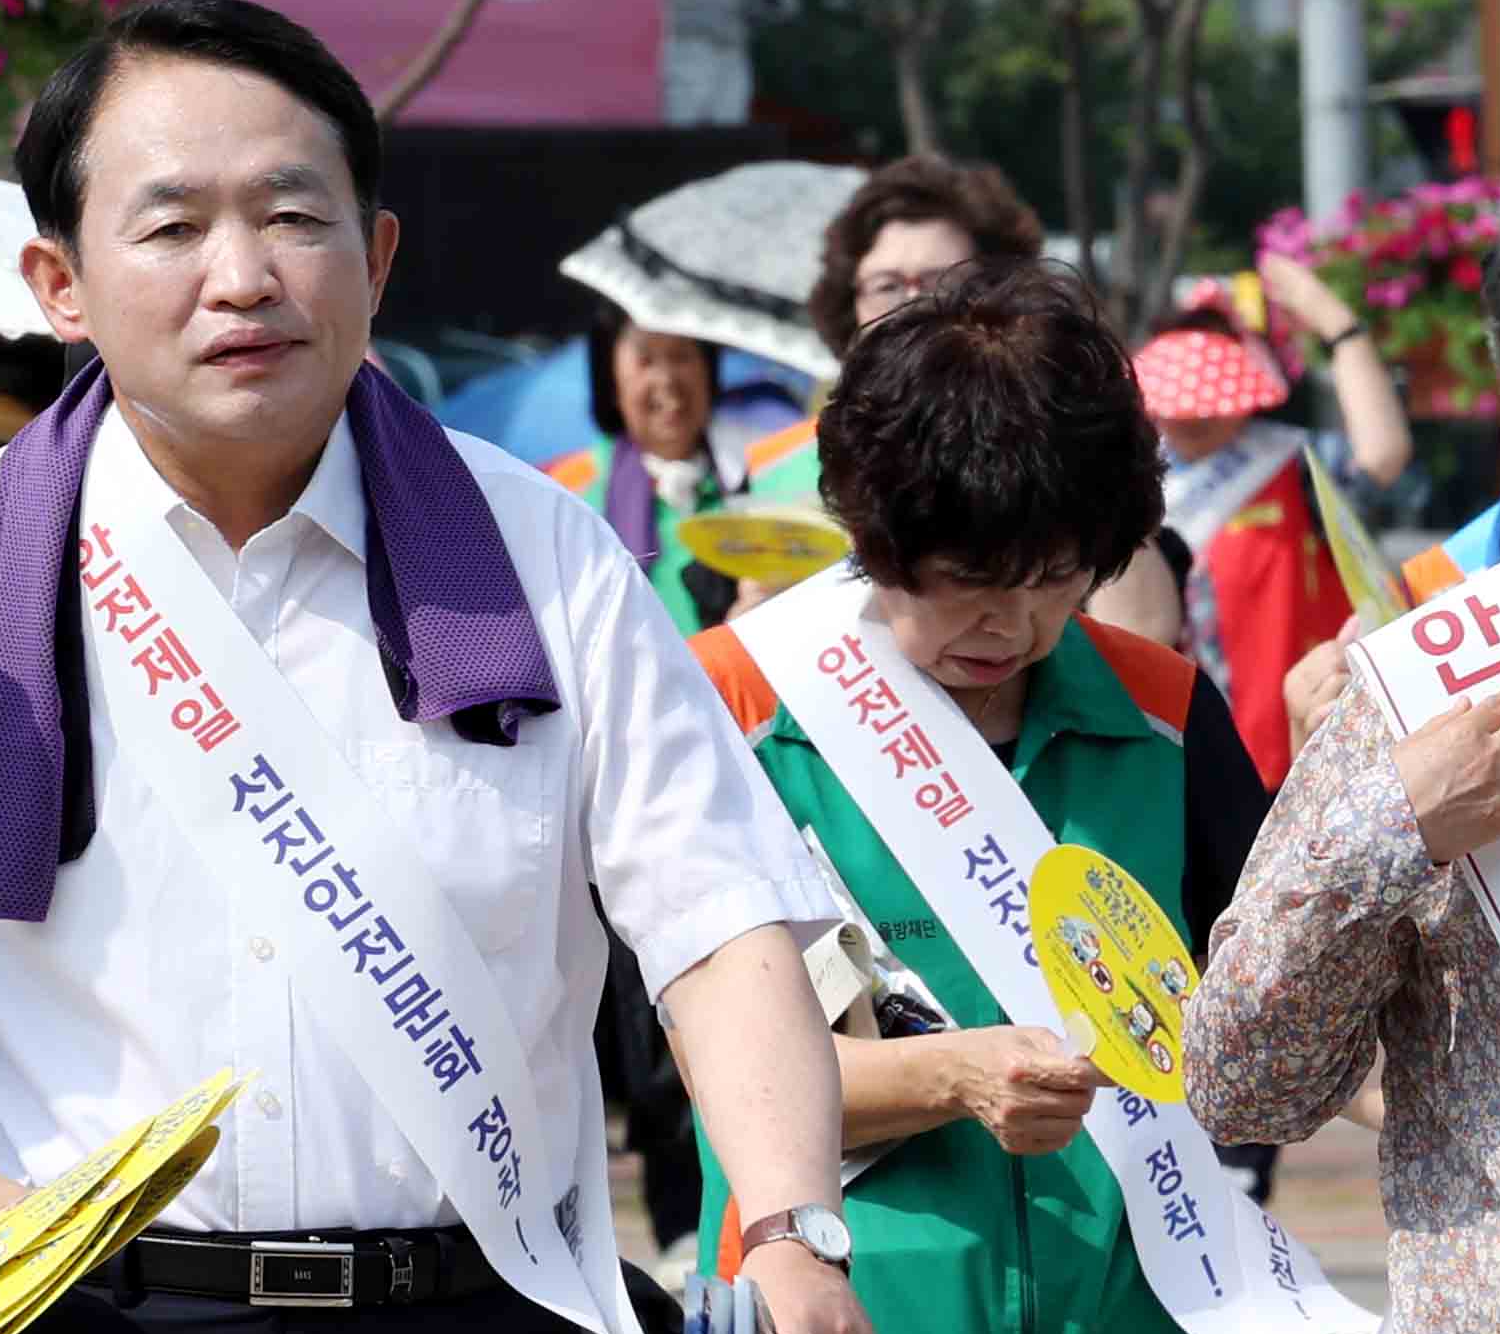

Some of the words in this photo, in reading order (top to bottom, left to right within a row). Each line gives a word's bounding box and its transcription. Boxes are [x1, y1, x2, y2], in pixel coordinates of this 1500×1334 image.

[78, 522, 241, 753] 안전제일
[229, 753, 483, 1094] 선진안전문화
[468, 1094, 521, 1210] 정착
[817, 633, 974, 828] 안전제일
[1145, 1139, 1206, 1242] 정착
